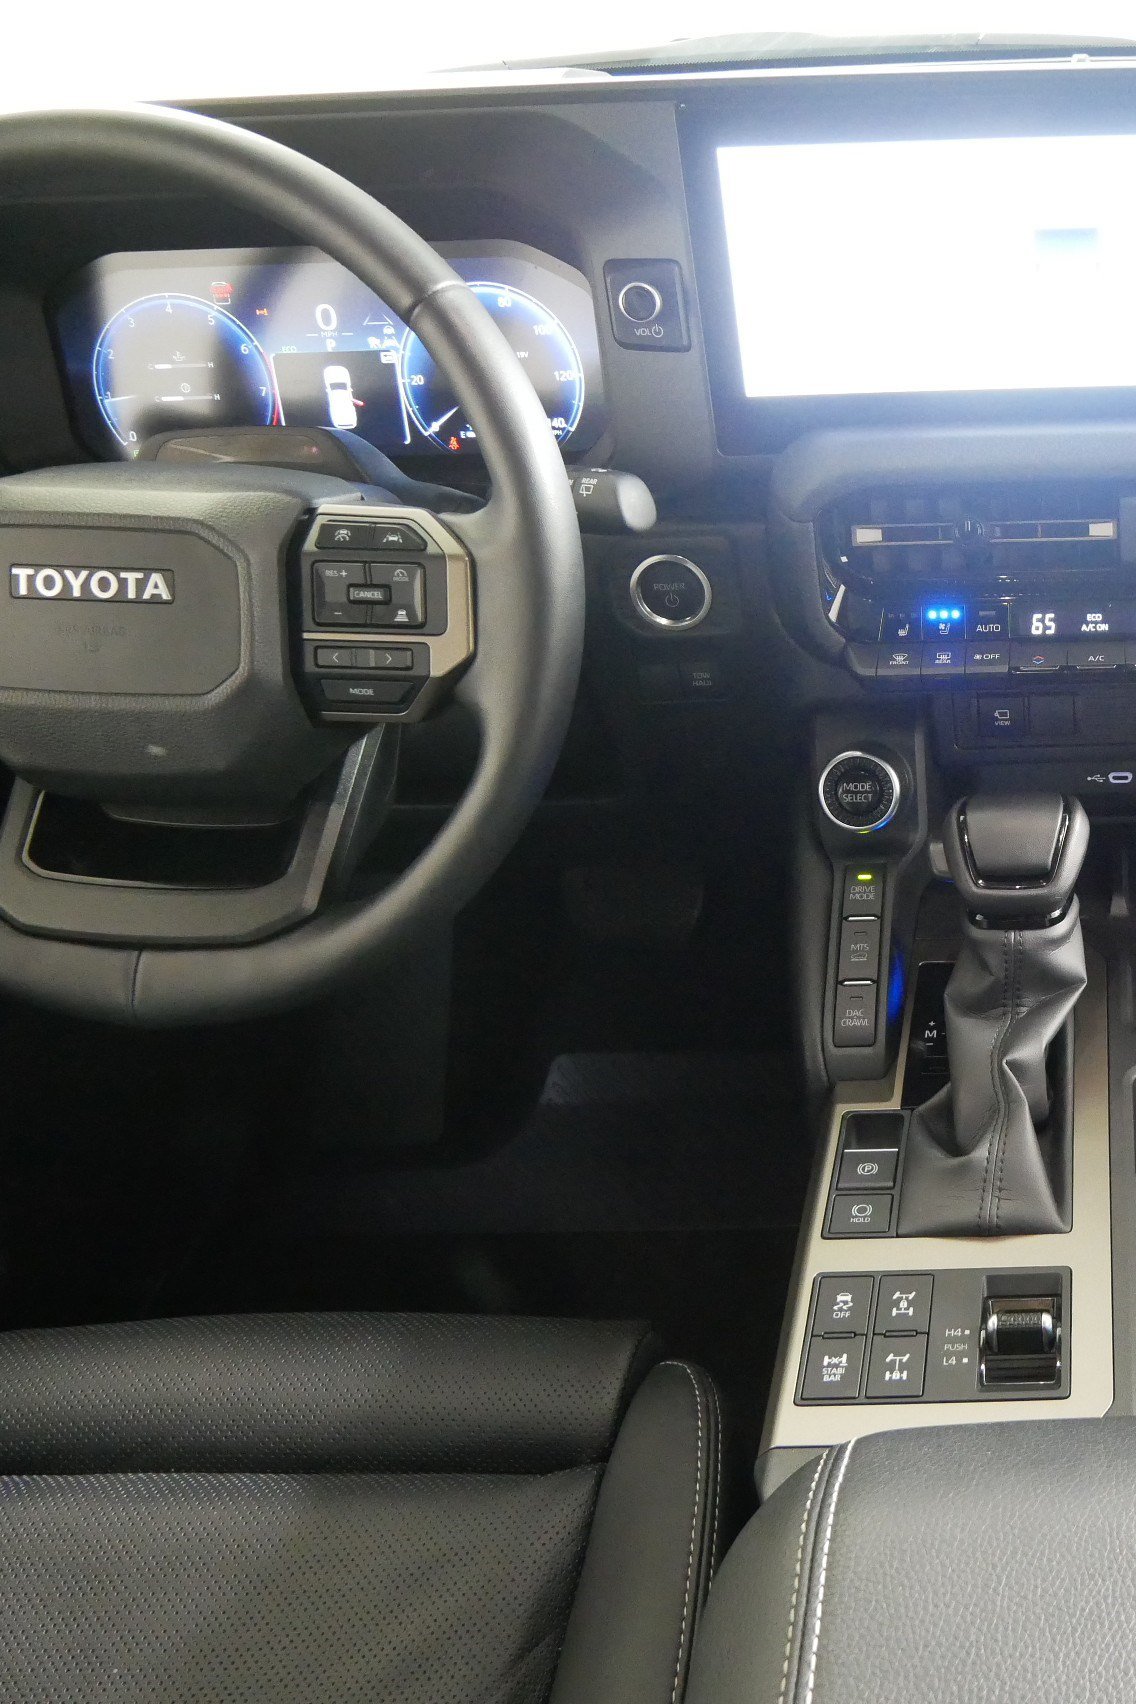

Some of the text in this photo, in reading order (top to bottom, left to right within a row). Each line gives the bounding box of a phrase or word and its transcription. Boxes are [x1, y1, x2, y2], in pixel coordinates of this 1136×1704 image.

[208, 314, 215, 325] 5
[315, 303, 338, 330] 0
[128, 317, 135, 327] 3
[634, 328, 651, 336] VOL
[241, 343, 249, 354] 6
[326, 338, 337, 350] P
[410, 374, 424, 386] 20
[260, 385, 267, 397] 7
[130, 431, 137, 441] 0
[460, 430, 467, 439] E
[325, 569, 338, 577] RES
[11, 567, 173, 600] TOYOTA
[354, 591, 383, 599] CANCEL
[1086, 613, 1103, 621] ECO
[976, 623, 1001, 632] AUTO
[1031, 612, 1056, 635] 65
[1081, 623, 1109, 631] A/C ON
[349, 687, 375, 696] MODE
[843, 782, 872, 791] MODE
[842, 793, 873, 803] SELECT
[850, 885, 876, 893] DRIVE
[849, 892, 876, 900] MODE
[850, 943, 870, 951] MTS
[846, 1009, 864, 1017] DAC
[841, 1018, 869, 1027] CRAWL
[924, 1029, 937, 1039] M
[832, 1311, 851, 1319] OFF
[945, 1328, 962, 1338] H4
[944, 1343, 968, 1351] PUSH
[943, 1356, 957, 1366] L4
[822, 1367, 846, 1375] STABI
[823, 1374, 842, 1382] BAR
